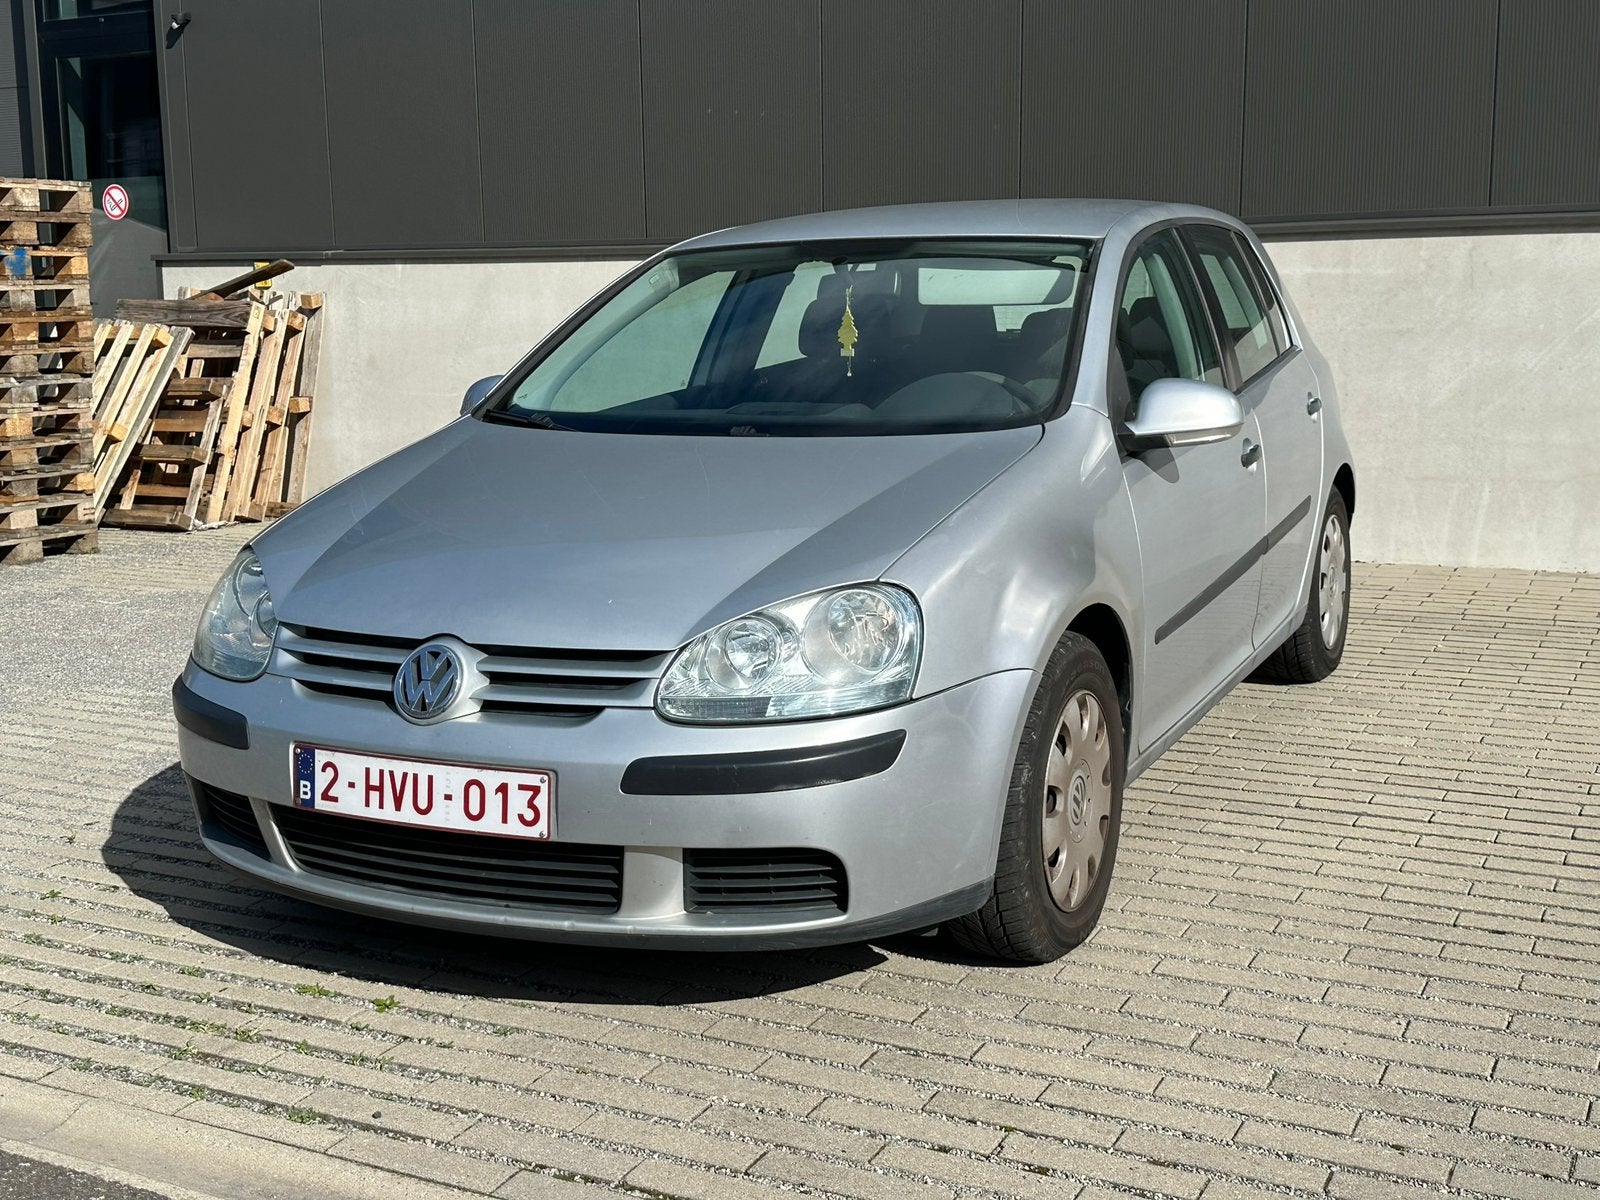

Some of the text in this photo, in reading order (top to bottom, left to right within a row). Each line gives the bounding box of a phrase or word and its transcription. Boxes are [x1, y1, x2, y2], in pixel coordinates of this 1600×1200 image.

[395, 644, 460, 718] VW
[299, 780, 312, 800] B
[320, 760, 542, 828] 2-HVU-013
